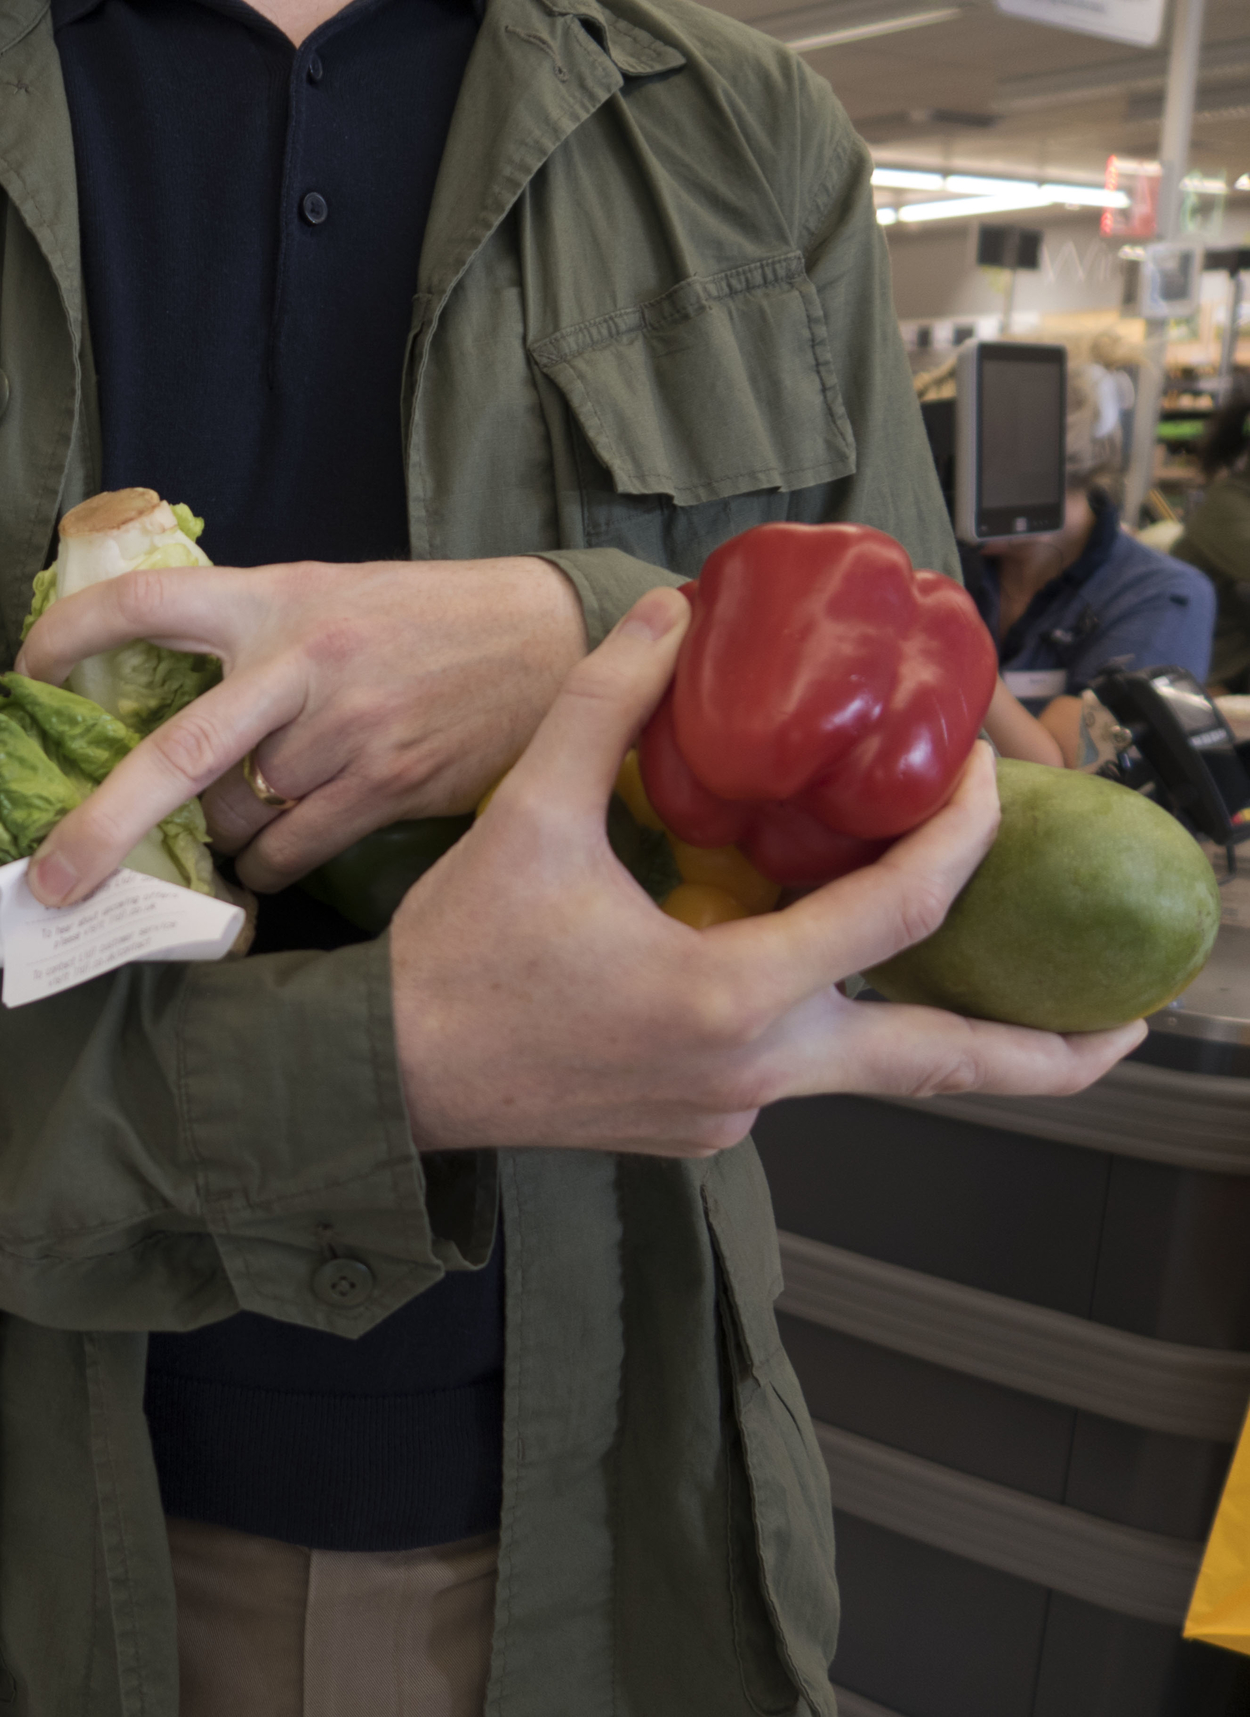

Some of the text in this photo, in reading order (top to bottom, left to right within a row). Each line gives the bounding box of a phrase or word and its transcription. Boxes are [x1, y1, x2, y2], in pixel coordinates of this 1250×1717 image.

[55, 922, 73, 936] hear
[78, 910, 98, 927] about
[45, 956, 76, 977] contact
[138, 920, 178, 935] service
[53, 931, 80, 951] please
